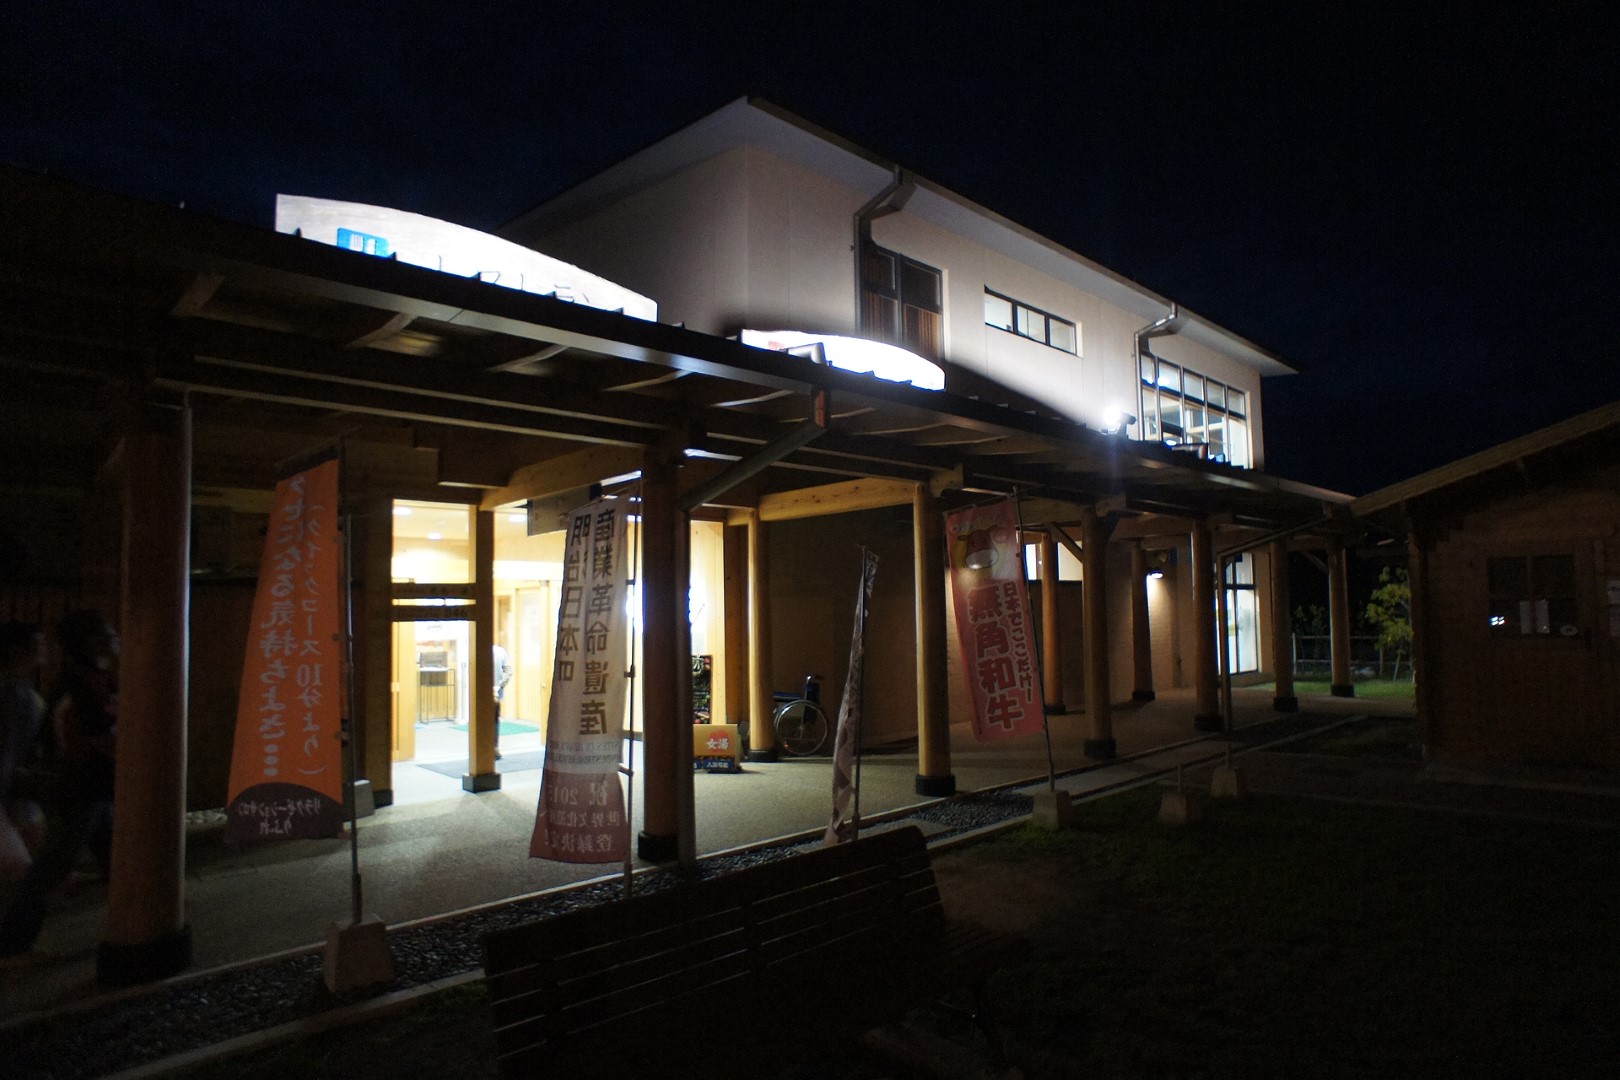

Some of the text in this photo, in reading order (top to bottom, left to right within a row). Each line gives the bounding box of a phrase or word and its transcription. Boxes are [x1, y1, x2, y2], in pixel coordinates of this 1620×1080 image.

[969, 586, 1024, 730] 無角和牛
[706, 738, 729, 750] 女湯
